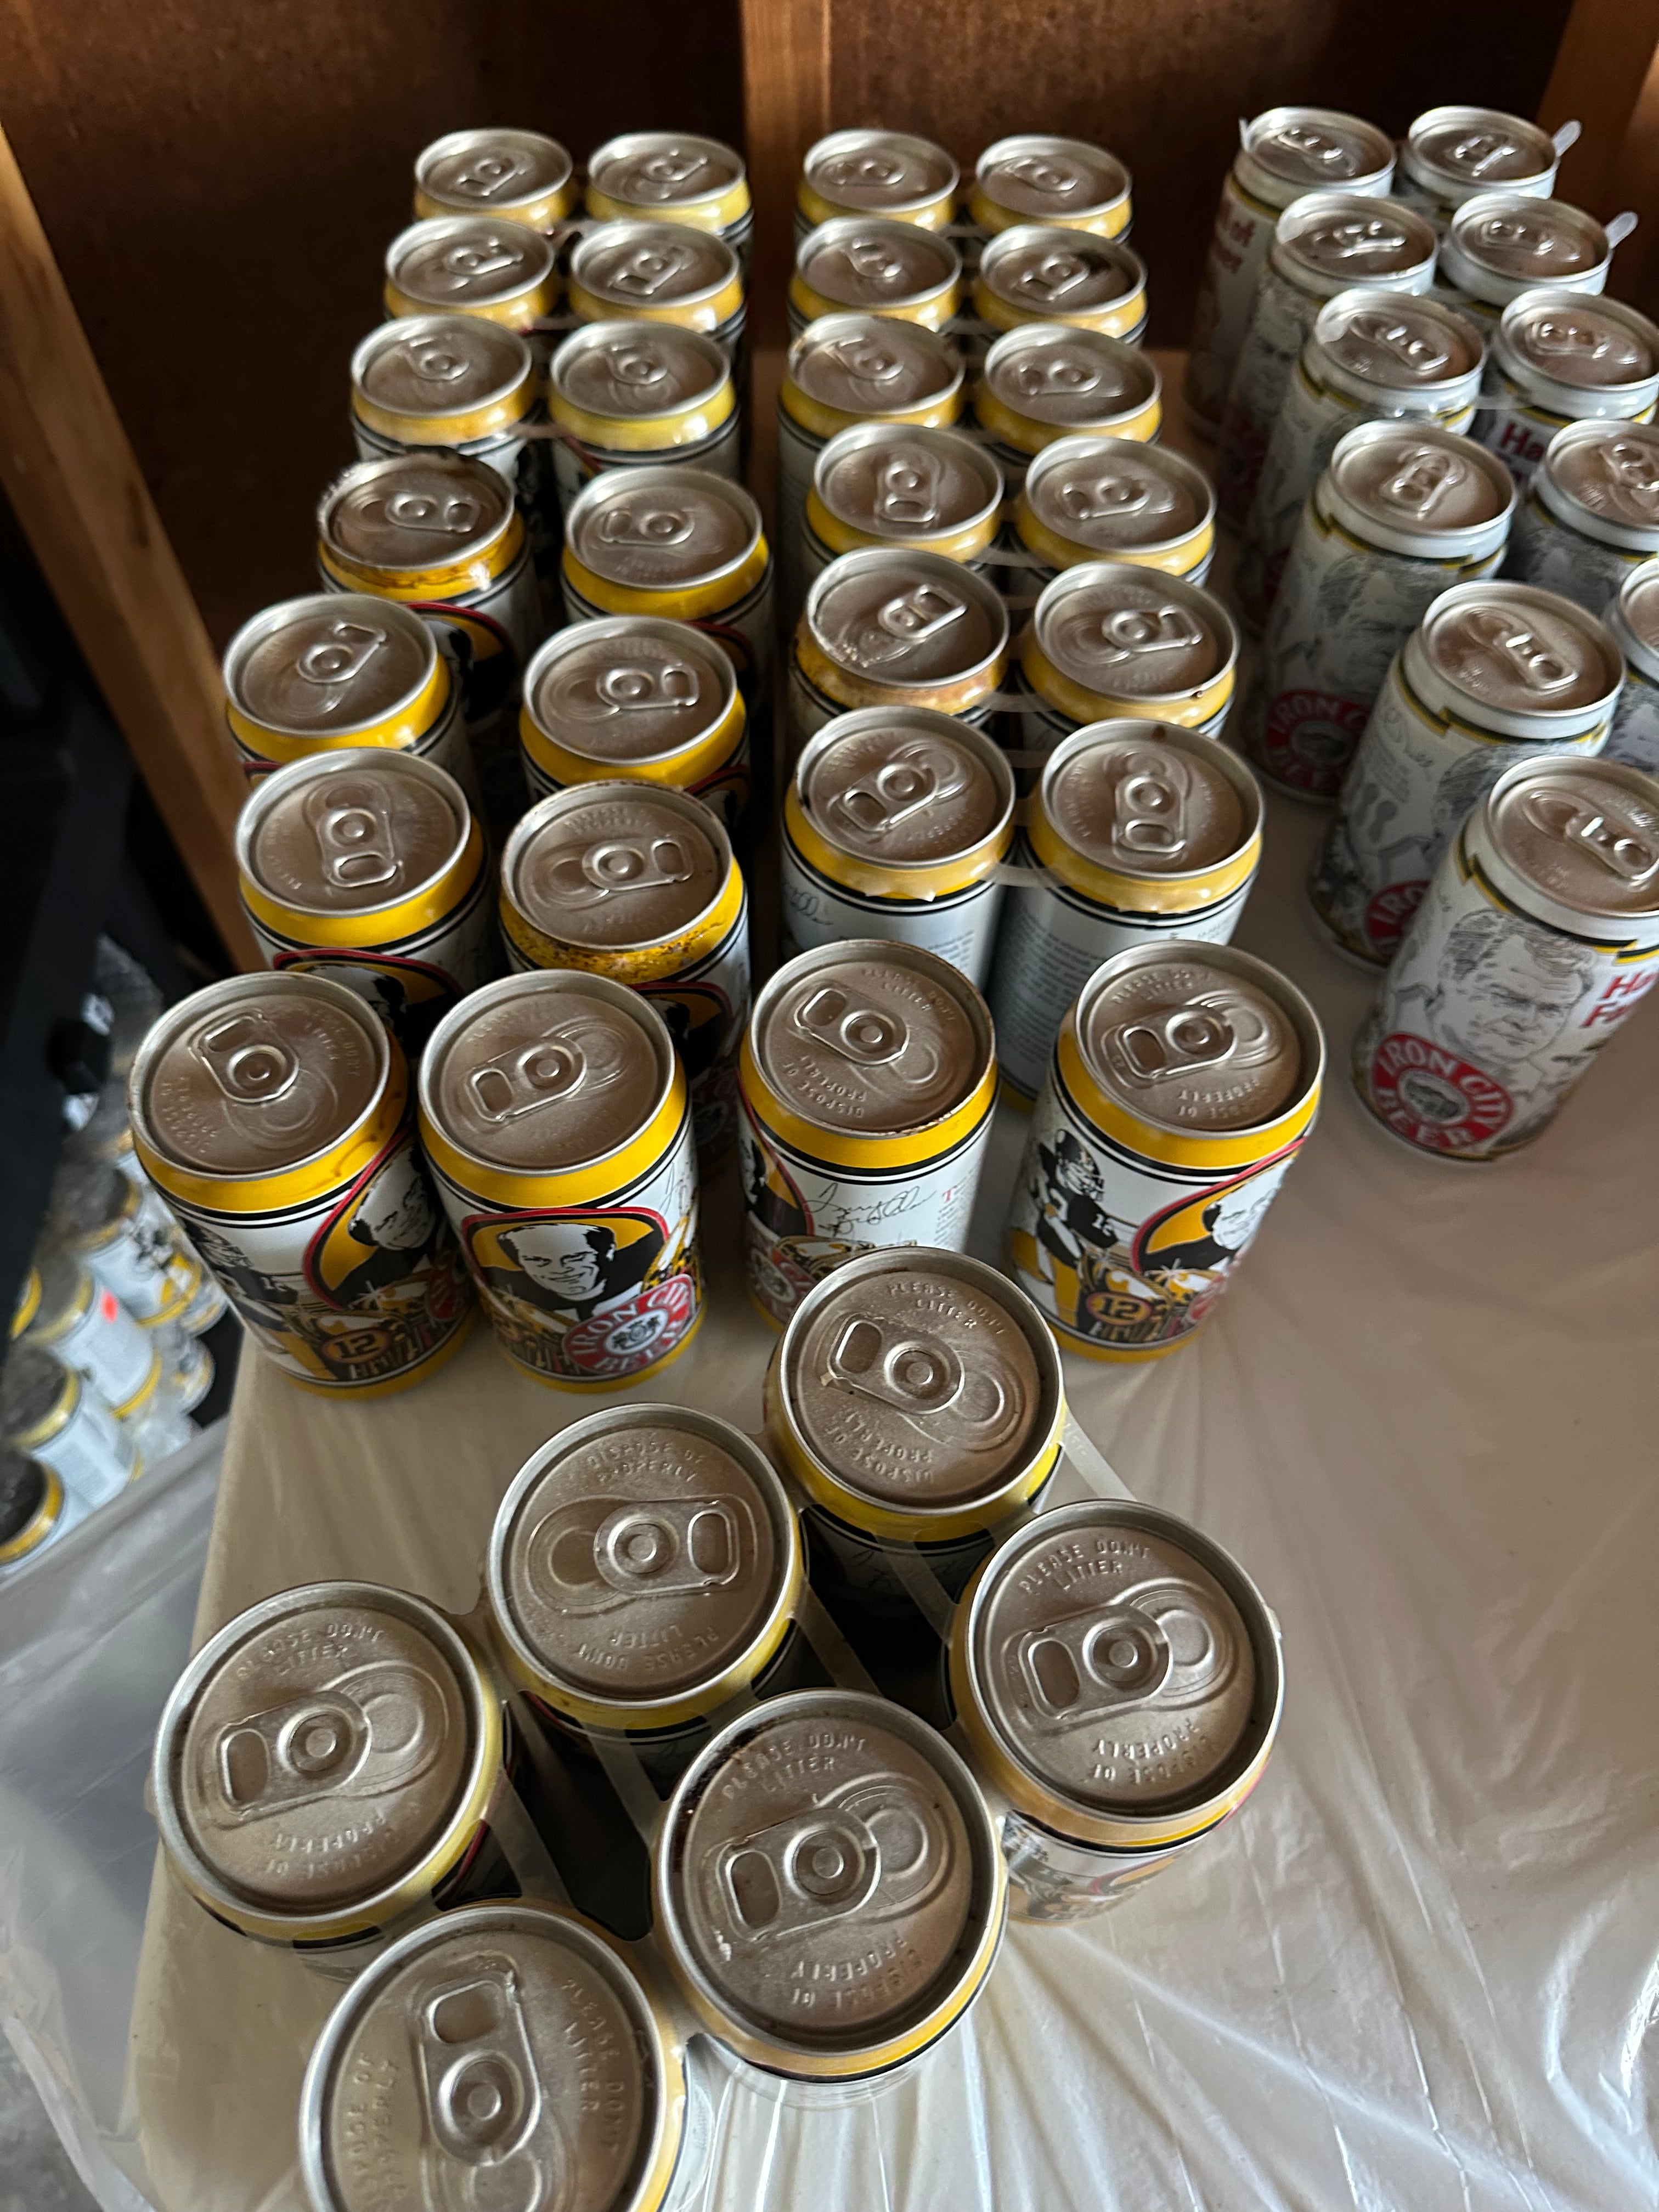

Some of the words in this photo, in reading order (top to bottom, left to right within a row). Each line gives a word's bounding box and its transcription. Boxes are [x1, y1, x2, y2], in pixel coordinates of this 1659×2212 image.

[1371, 887, 1426, 925] IRO
[1377, 1039, 1458, 1077] IRON
[1459, 1074, 1508, 1132] CITY
[1376, 1087, 1476, 1148] BEER
[570, 1303, 638, 1356] IRON
[647, 1282, 690, 1313] CITY
[1097, 1295, 1141, 1321] 12
[334, 1333, 381, 1359] 12
[592, 1320, 681, 1373] BEER
[1017, 1543, 1085, 1595] PLEASE
[1056, 1560, 1124, 1593] LITTER
